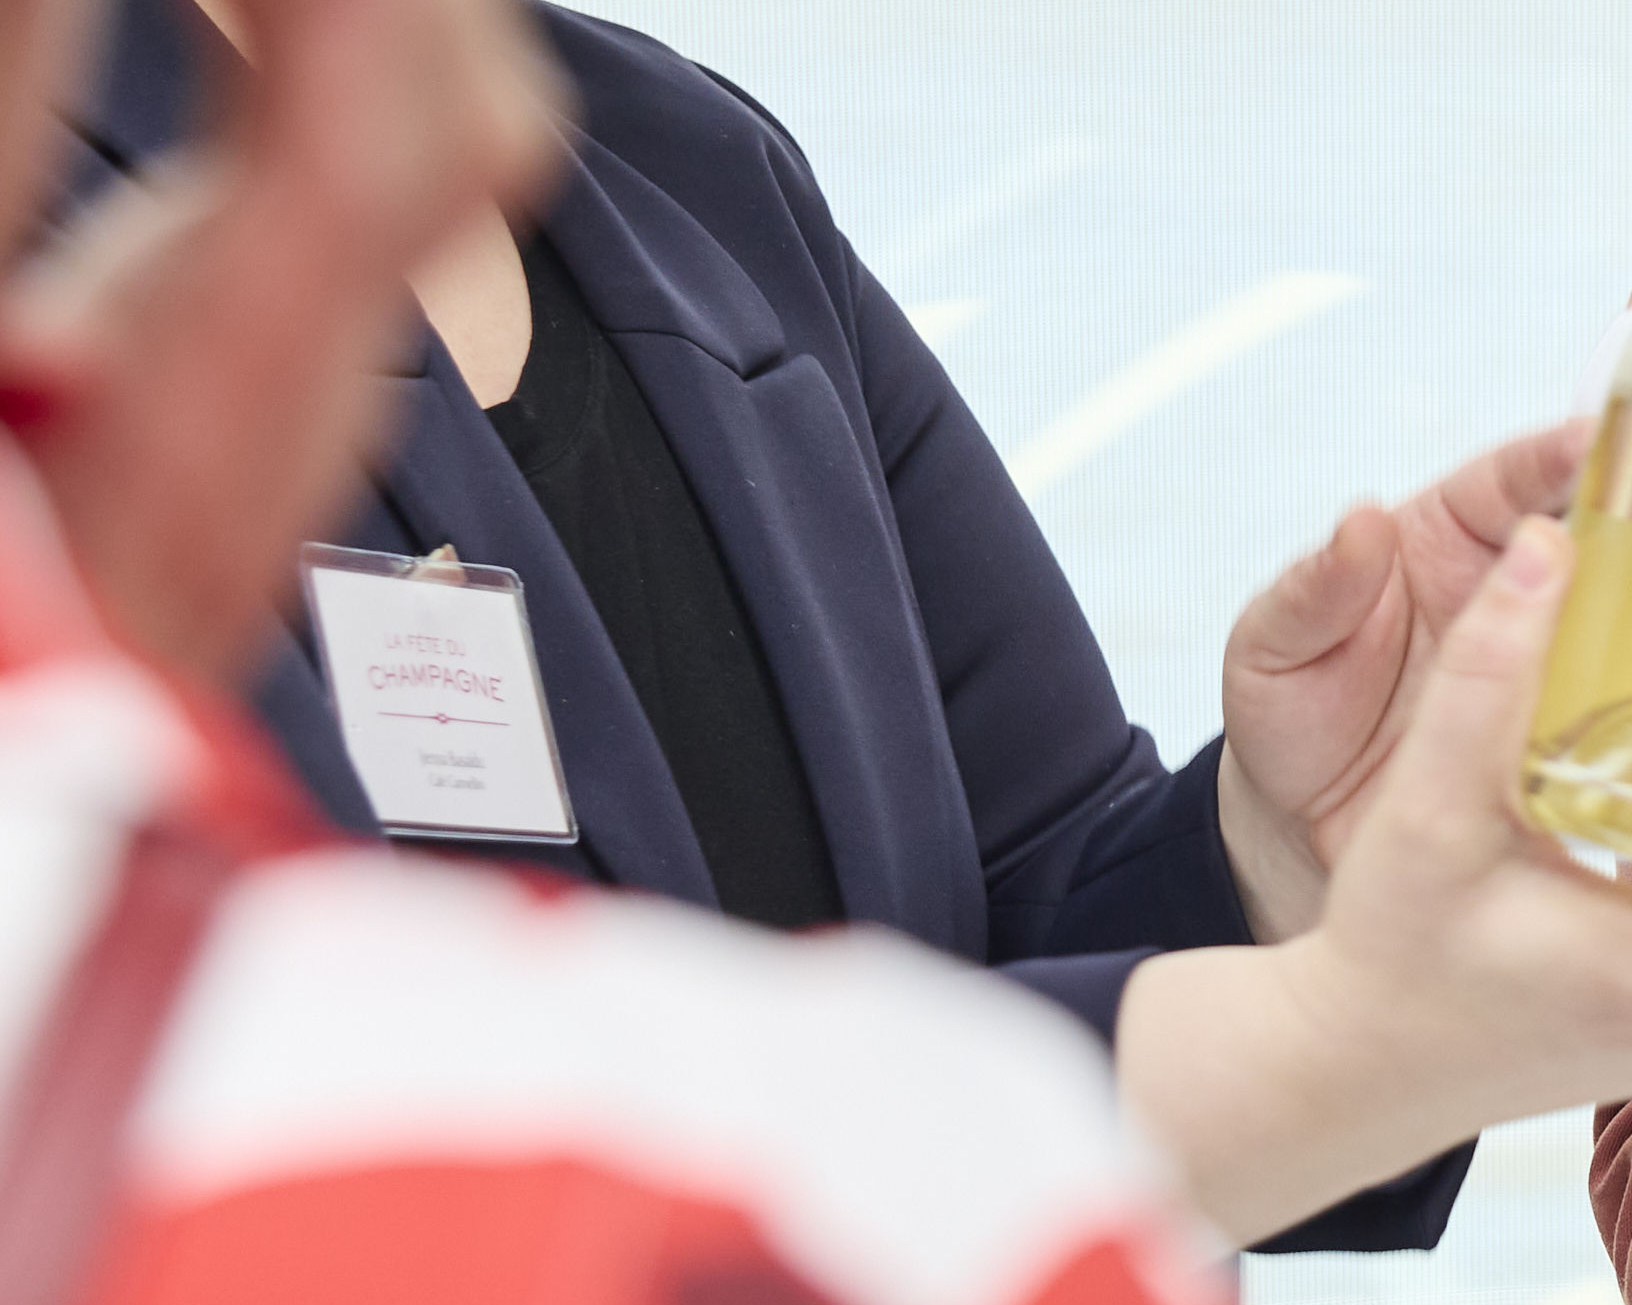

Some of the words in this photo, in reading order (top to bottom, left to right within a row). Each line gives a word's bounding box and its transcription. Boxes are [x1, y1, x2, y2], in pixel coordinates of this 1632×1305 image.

[384, 633, 402, 649] LA
[446, 639, 466, 657] DU
[368, 664, 505, 702] CHAMPAGNE
